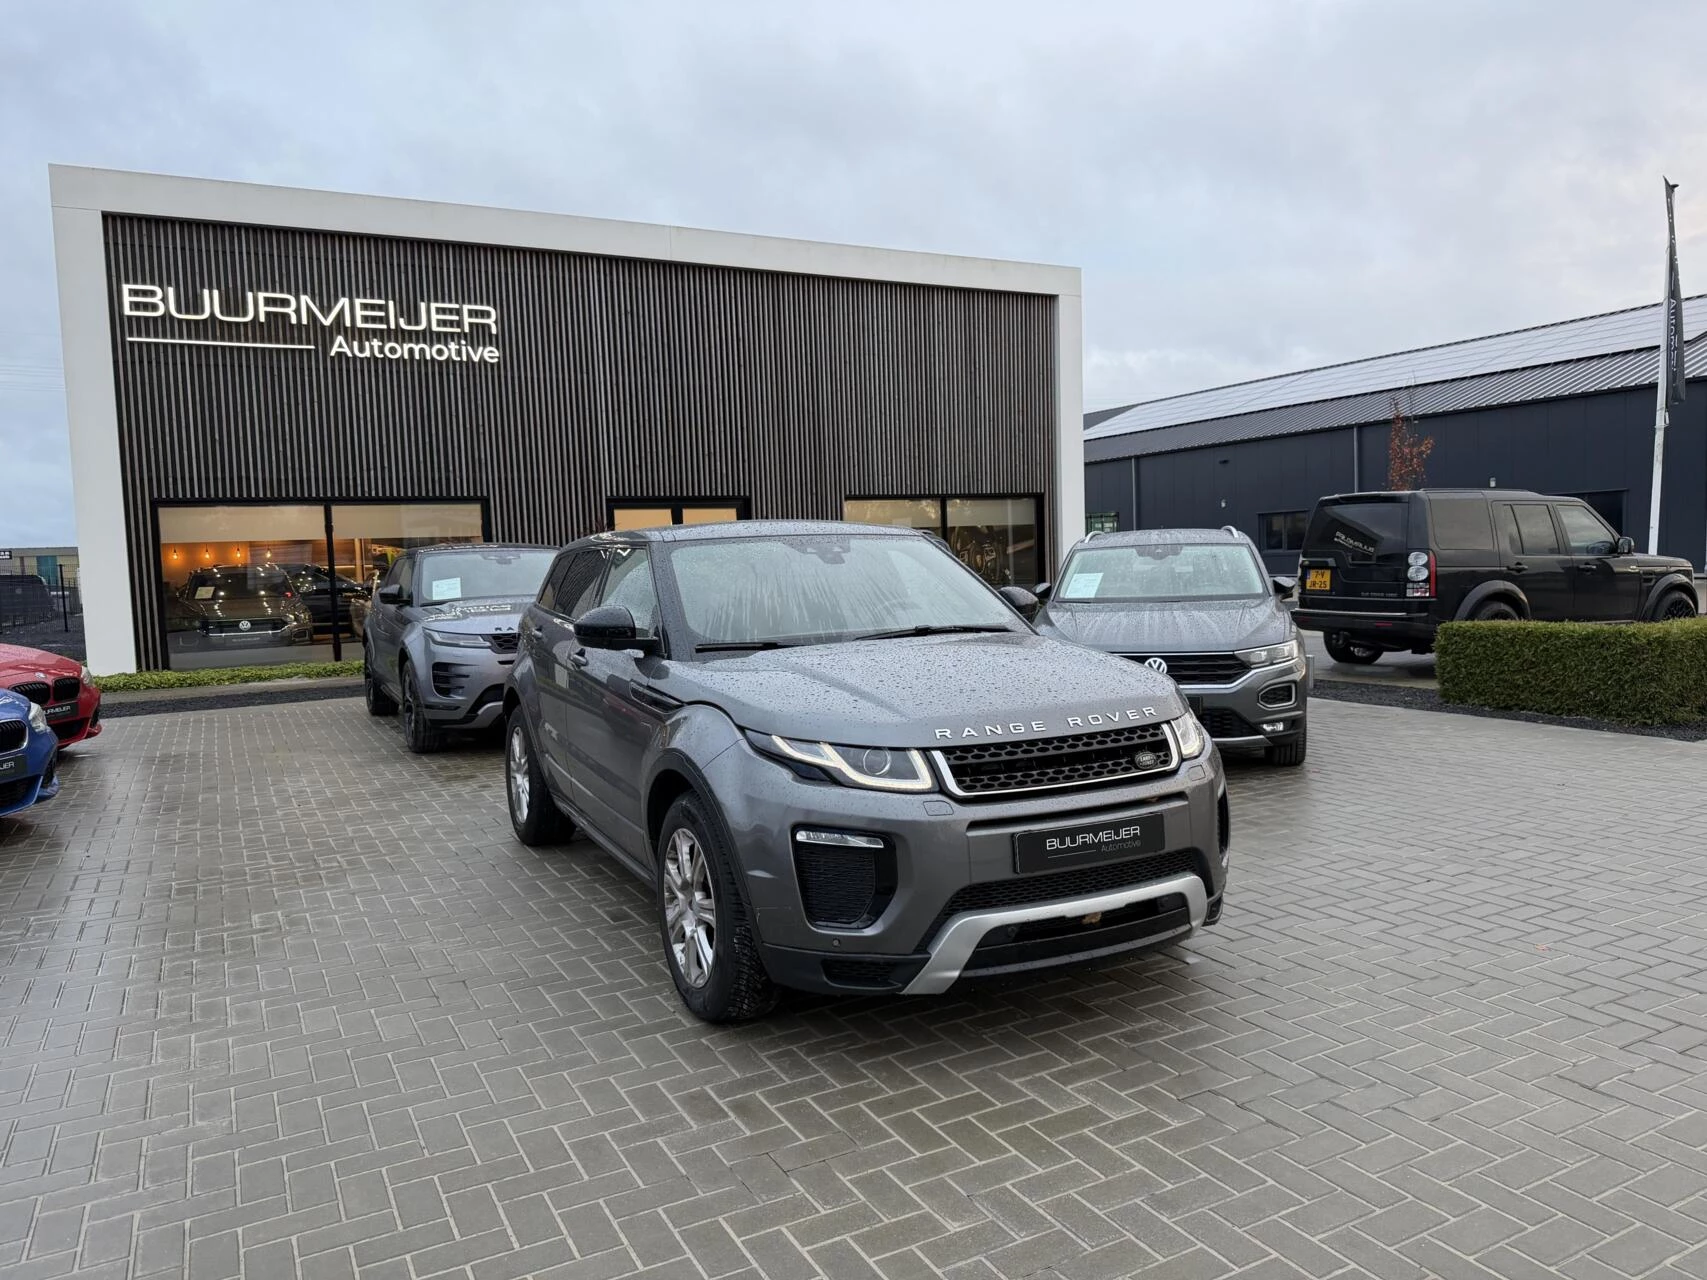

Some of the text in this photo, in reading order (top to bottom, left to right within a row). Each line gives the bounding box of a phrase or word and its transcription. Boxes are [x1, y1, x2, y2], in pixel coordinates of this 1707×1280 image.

[122, 283, 498, 335] BUURMEIJER
[329, 335, 500, 363] Automotive
[935, 706, 1159, 740] RANGE ROVER
[1046, 825, 1141, 850] BUURMEIJER
[1101, 838, 1142, 853] Automotive
